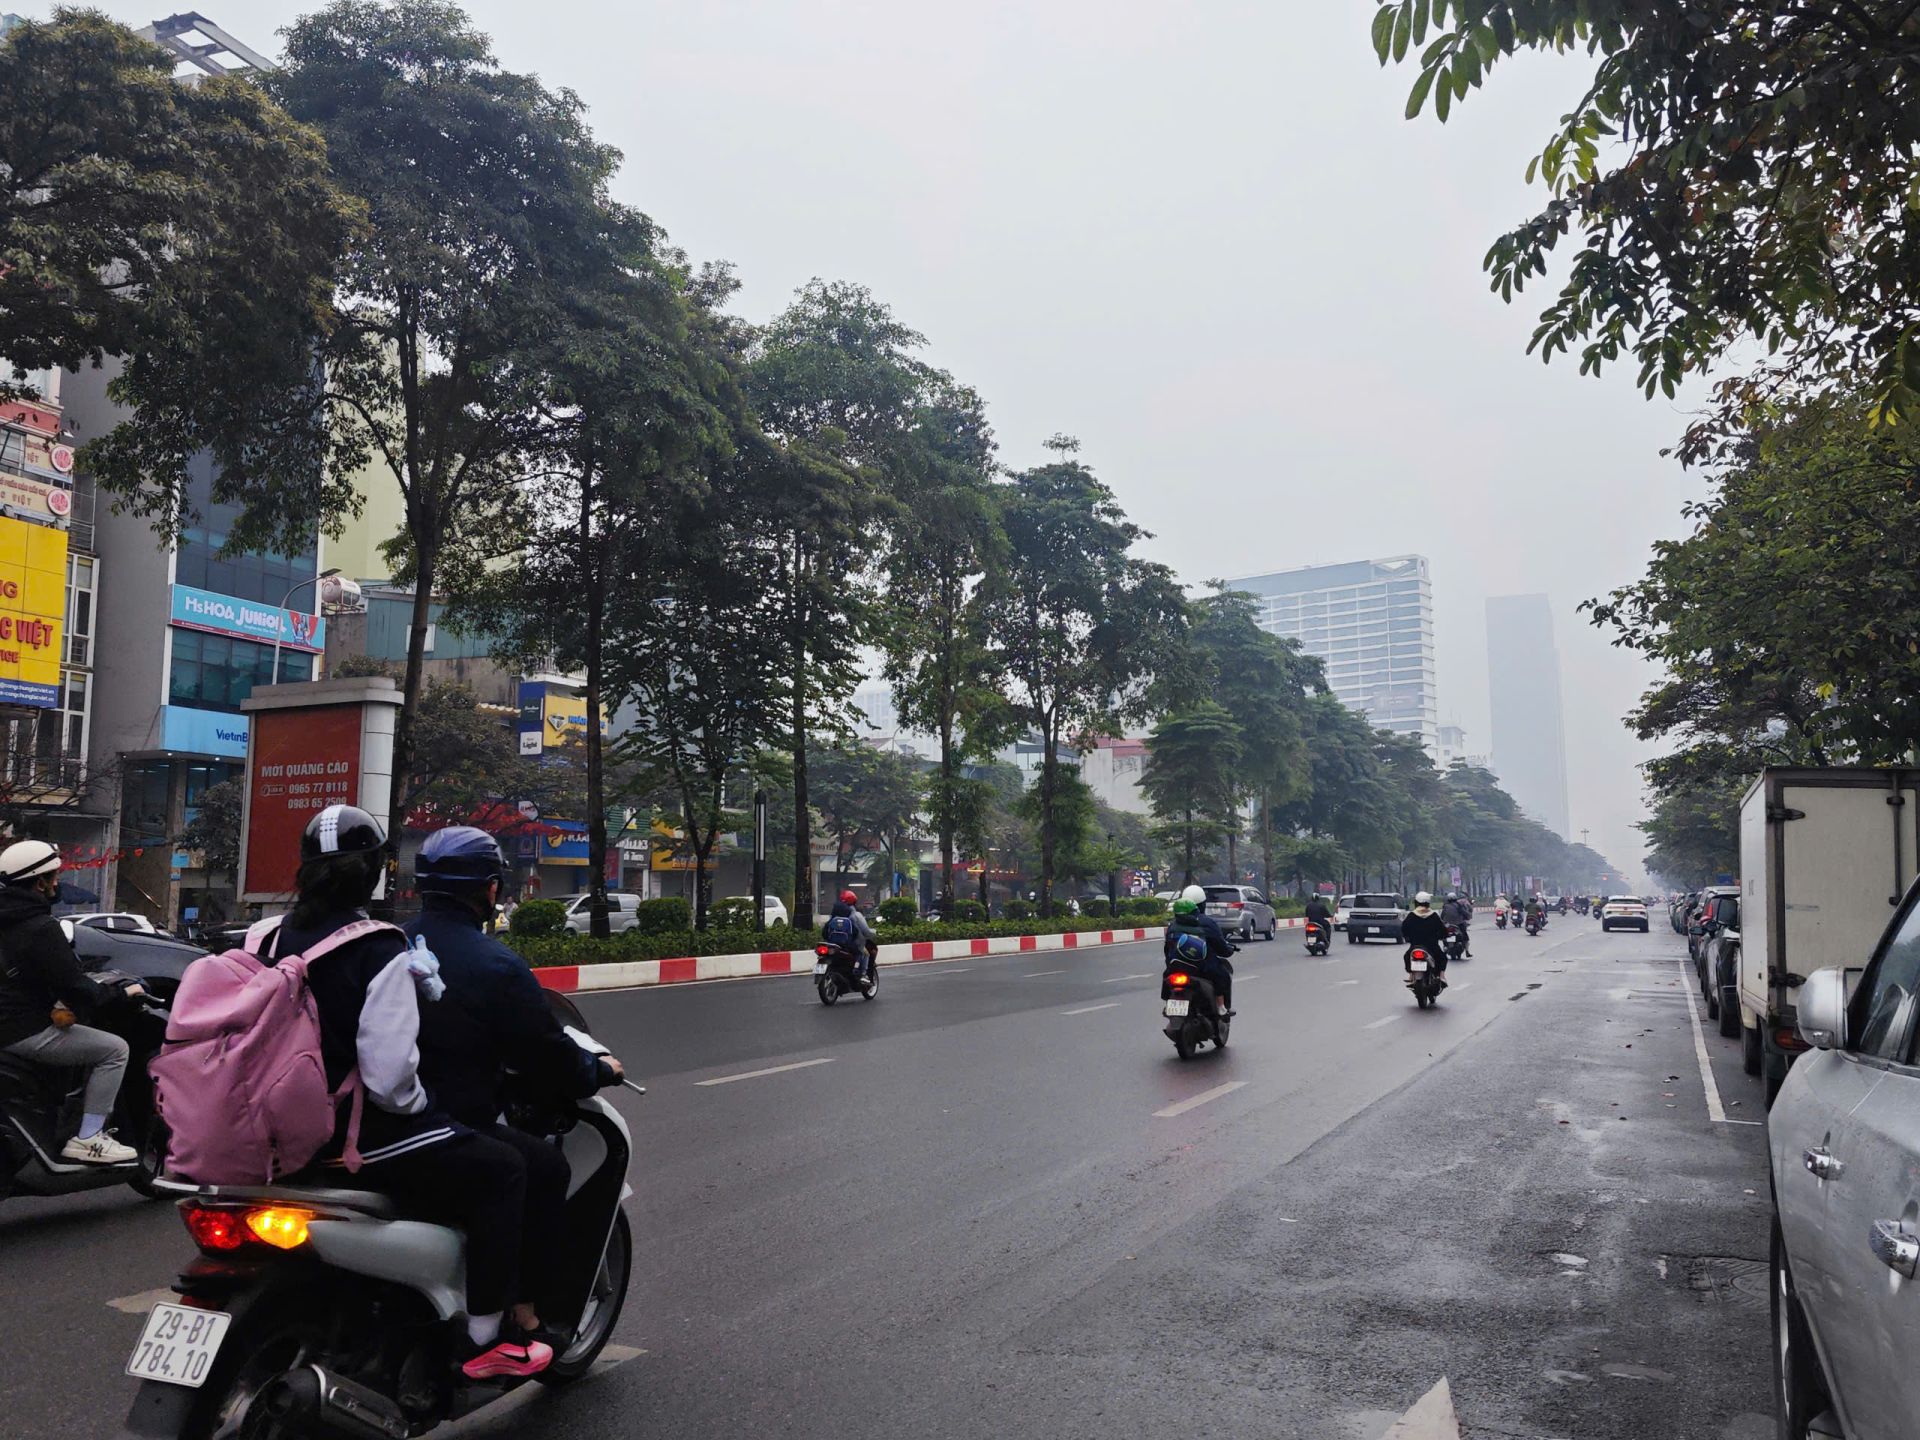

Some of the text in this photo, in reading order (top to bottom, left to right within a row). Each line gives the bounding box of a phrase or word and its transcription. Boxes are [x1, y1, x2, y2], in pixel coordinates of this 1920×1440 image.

[16, 617, 53, 650] VIỆT
[286, 760, 324, 778] QUẢNG
[327, 760, 349, 774] CÁO
[289, 783, 310, 794] 0965
[312, 782, 324, 793] 77
[287, 798, 309, 809] 0983
[311, 797, 323, 808] 65
[154, 1310, 217, 1346] 29-B1
[134, 1341, 208, 1380] 784.10
